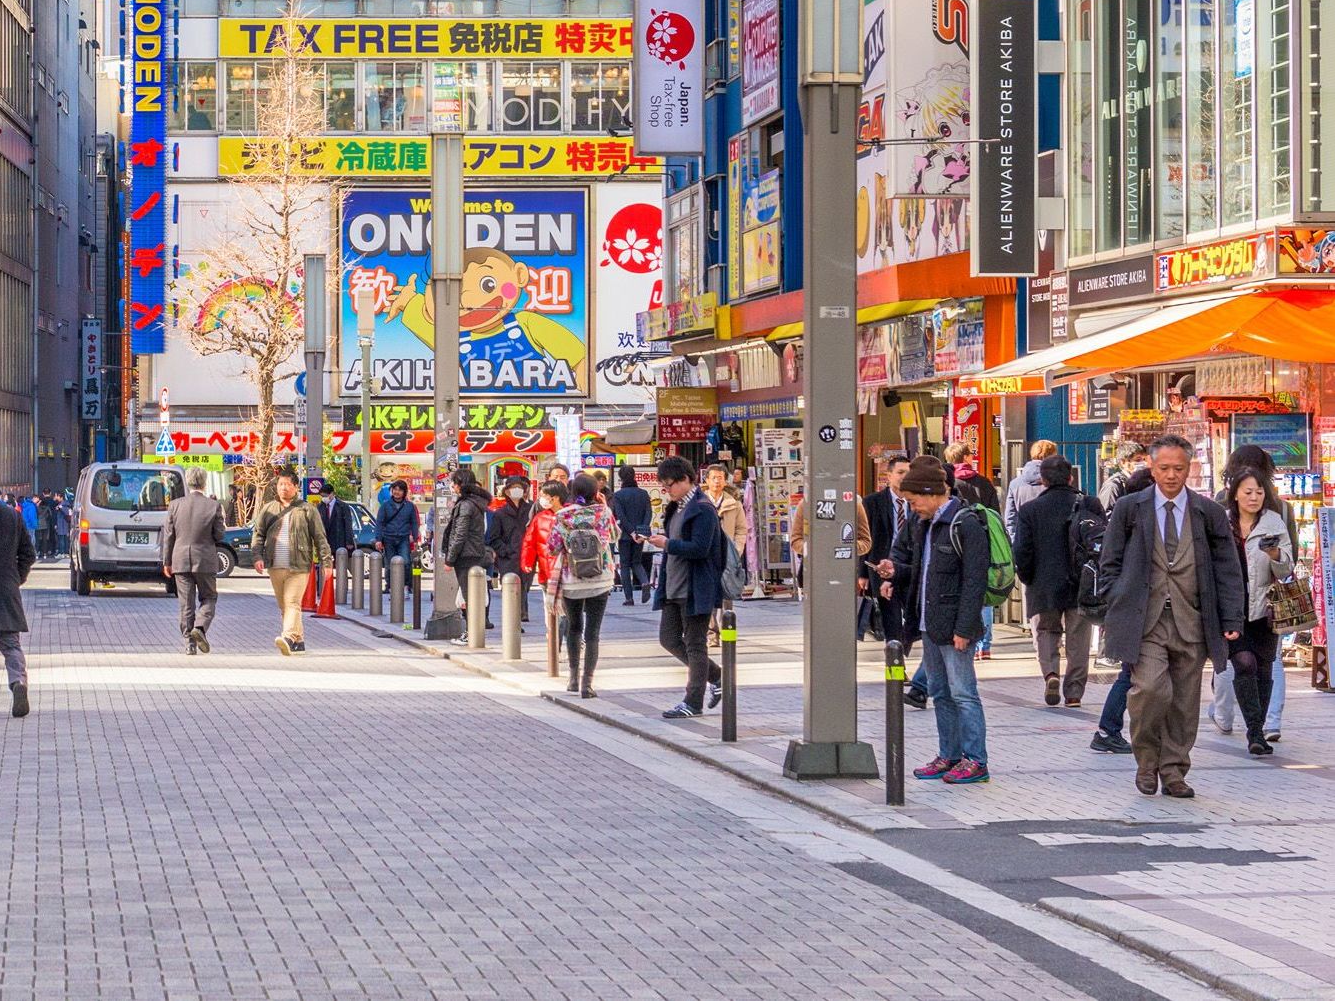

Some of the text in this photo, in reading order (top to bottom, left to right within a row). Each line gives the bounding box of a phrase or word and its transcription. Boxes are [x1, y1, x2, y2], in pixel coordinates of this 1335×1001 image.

[239, 24, 440, 54] TAX FREE
[448, 22, 543, 54] 免税店
[648, 94, 663, 128] Shop
[663, 75, 676, 128] Tax-free
[678, 81, 691, 127] Japan.
[1000, 15, 1013, 255] ALIENWARE STORE AKIBA
[335, 141, 428, 171] 冷蔵庫
[410, 198, 514, 214] Weme to
[349, 214, 572, 251] ONDEN
[526, 268, 570, 311] 迎
[1077, 278, 1110, 293] ALIENWARE
[1109, 273, 1128, 288] STORE
[1128, 269, 1147, 285] AKIBA
[469, 406, 545, 430] オノデン
[383, 430, 544, 451] オデン
[817, 501, 836, 514] 24K
